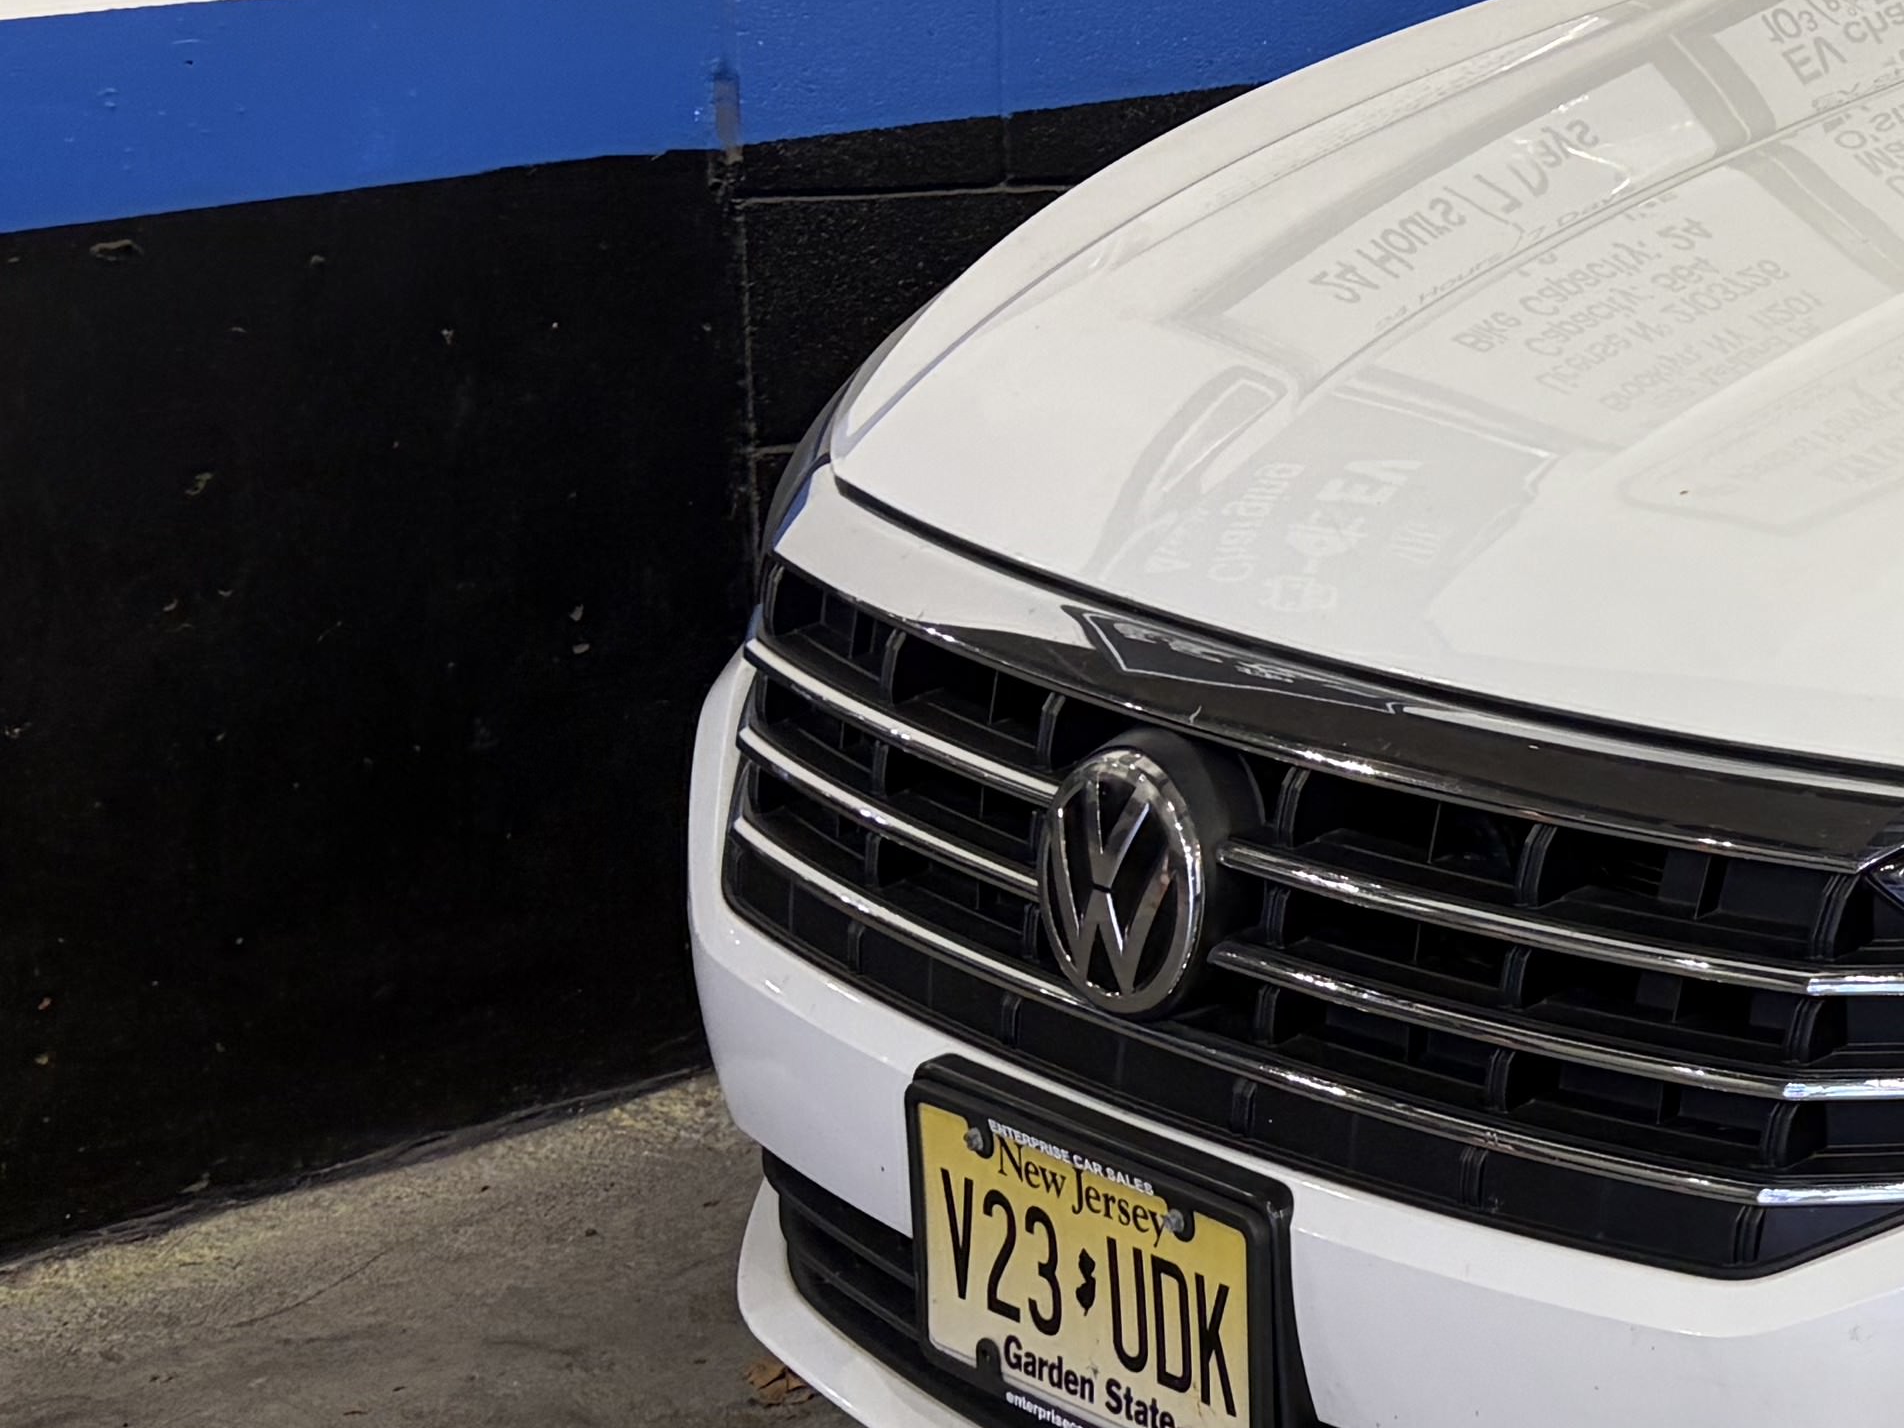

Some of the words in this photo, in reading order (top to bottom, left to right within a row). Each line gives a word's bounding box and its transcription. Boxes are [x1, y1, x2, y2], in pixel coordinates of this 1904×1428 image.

[987, 1118, 1071, 1164] ENTERPRISE
[1072, 1154, 1105, 1177] CAR
[1106, 1167, 1154, 1197] SALES
[997, 1133, 1066, 1199] New
[1072, 1167, 1166, 1248] Jersey
[1003, 1334, 1095, 1404] Garden
